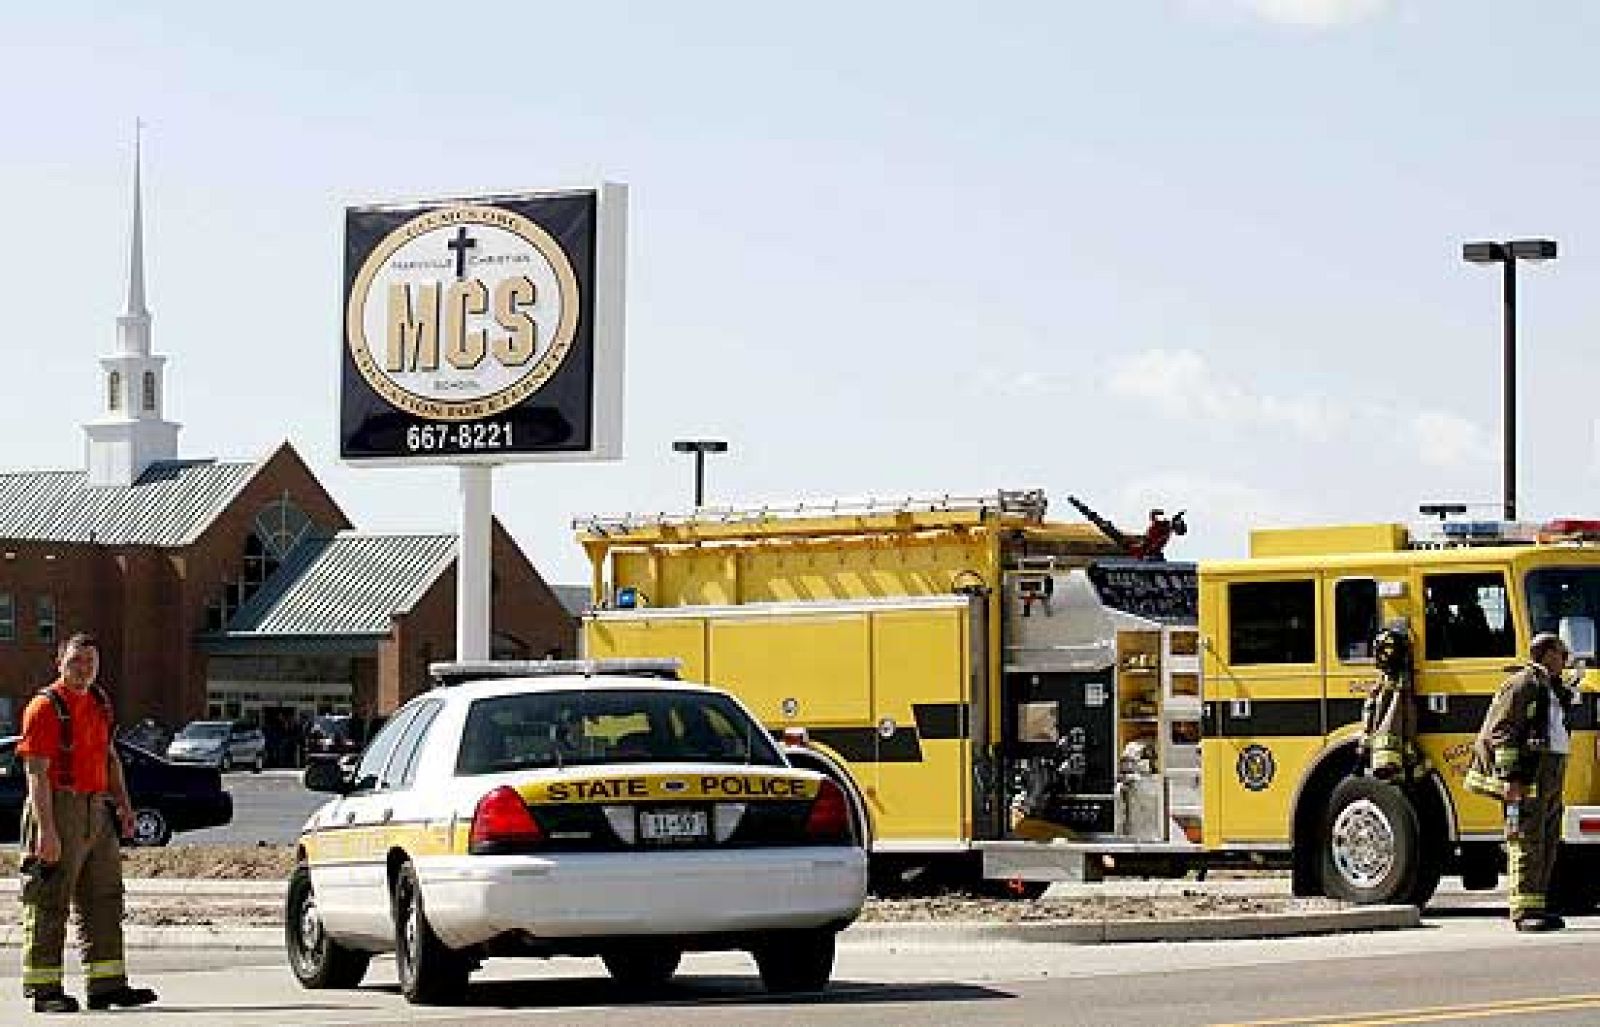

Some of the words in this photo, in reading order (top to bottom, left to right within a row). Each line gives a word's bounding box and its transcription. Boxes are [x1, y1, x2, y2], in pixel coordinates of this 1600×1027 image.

[468, 254, 531, 267] CHRISTIAN
[385, 276, 538, 373] MCS
[406, 421, 514, 452] 667-8221
[546, 778, 650, 801] STATE
[700, 775, 806, 797] POLICE
